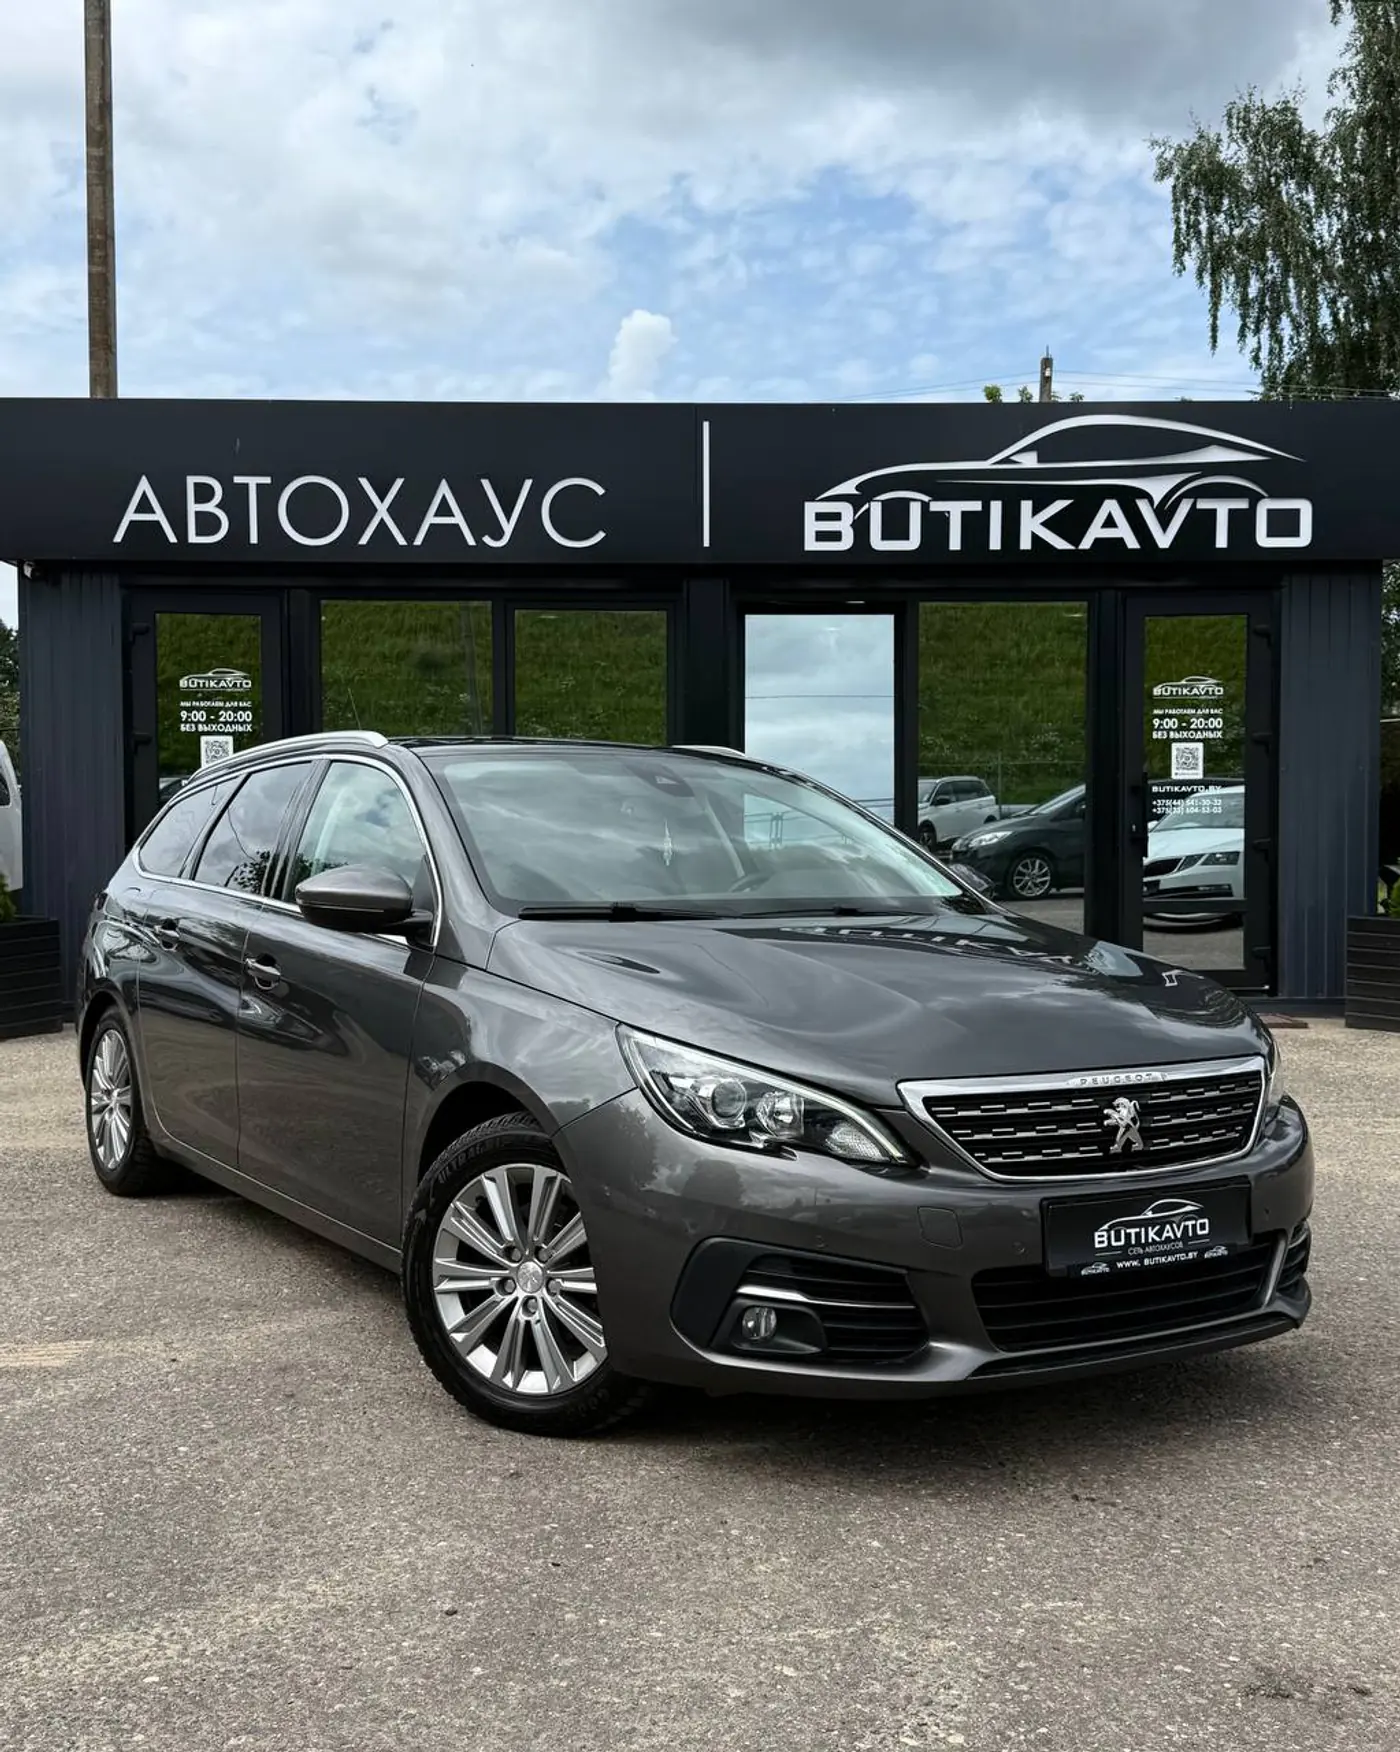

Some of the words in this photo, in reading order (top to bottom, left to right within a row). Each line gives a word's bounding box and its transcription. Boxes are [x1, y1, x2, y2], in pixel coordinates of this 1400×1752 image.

[113, 474, 607, 548] АВТОХАУС
[804, 497, 1313, 552] BUTIKAVTO
[179, 679, 252, 688] BUTIKAVTO
[1152, 687, 1224, 696] BUTIKAVTO
[180, 710, 206, 722] 9:00
[219, 710, 253, 722] 20:00
[180, 723, 196, 732] БЕЗ
[198, 723, 253, 732] ВЫХОДНЫХ
[1152, 717, 1178, 729] 9:00
[1190, 717, 1223, 729] 20:00
[1152, 731, 1168, 739] БЕЗ
[1169, 731, 1223, 739] ВЫХОДНЫХ
[1152, 785, 1221, 793] BUTIKAVTO.BY
[1080, 1073, 1152, 1086] PEUGEOT
[1094, 1218, 1209, 1249] BUTIKAVTO
[1143, 1251, 1199, 1266] BUTIKAVTO.BY
